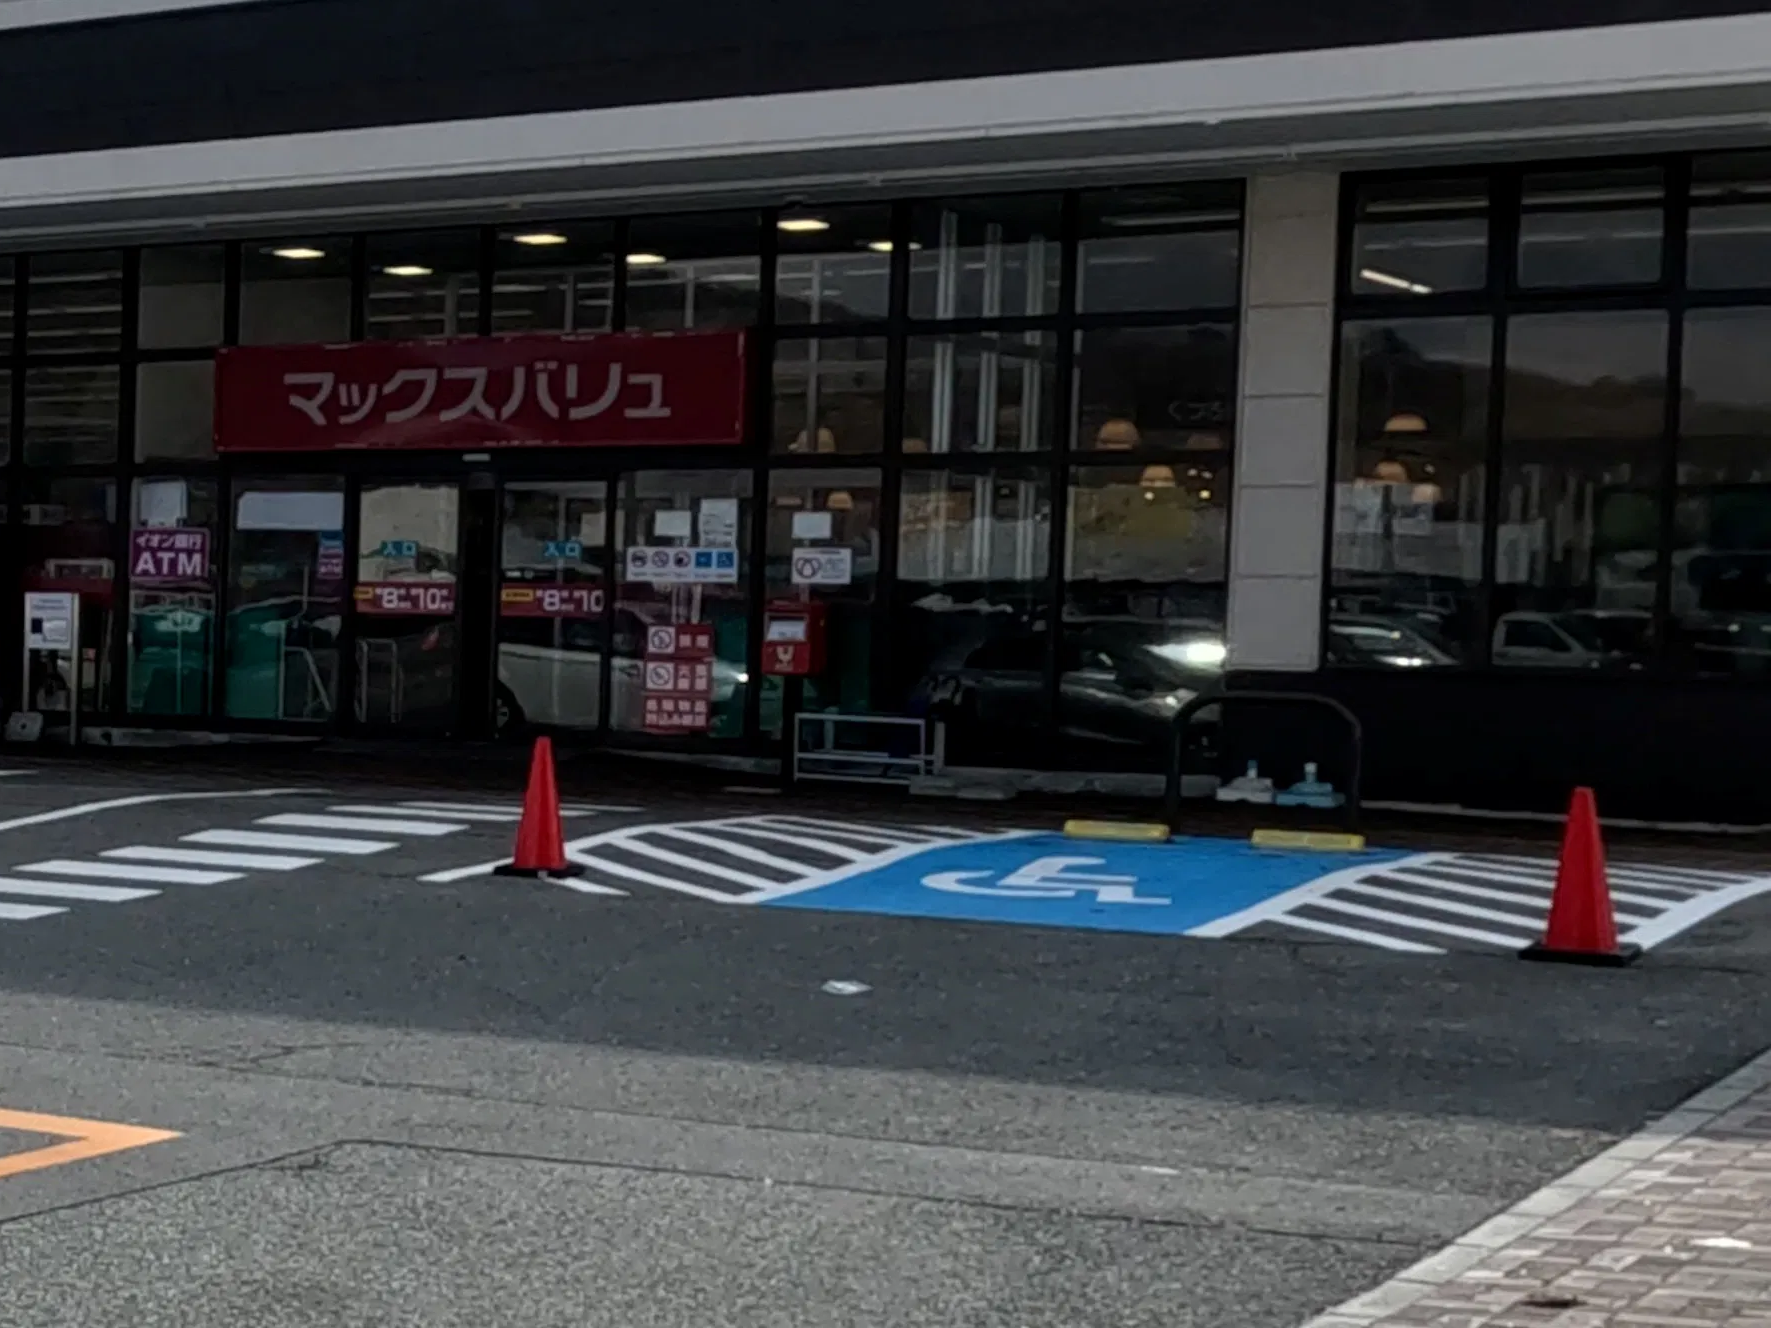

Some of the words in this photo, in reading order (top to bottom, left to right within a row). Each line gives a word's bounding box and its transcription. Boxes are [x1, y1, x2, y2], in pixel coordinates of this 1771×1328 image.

[282, 360, 672, 427] マックスバリュ
[382, 541, 417, 557] 入口
[543, 541, 581, 558] 入口
[134, 551, 203, 577] ATM
